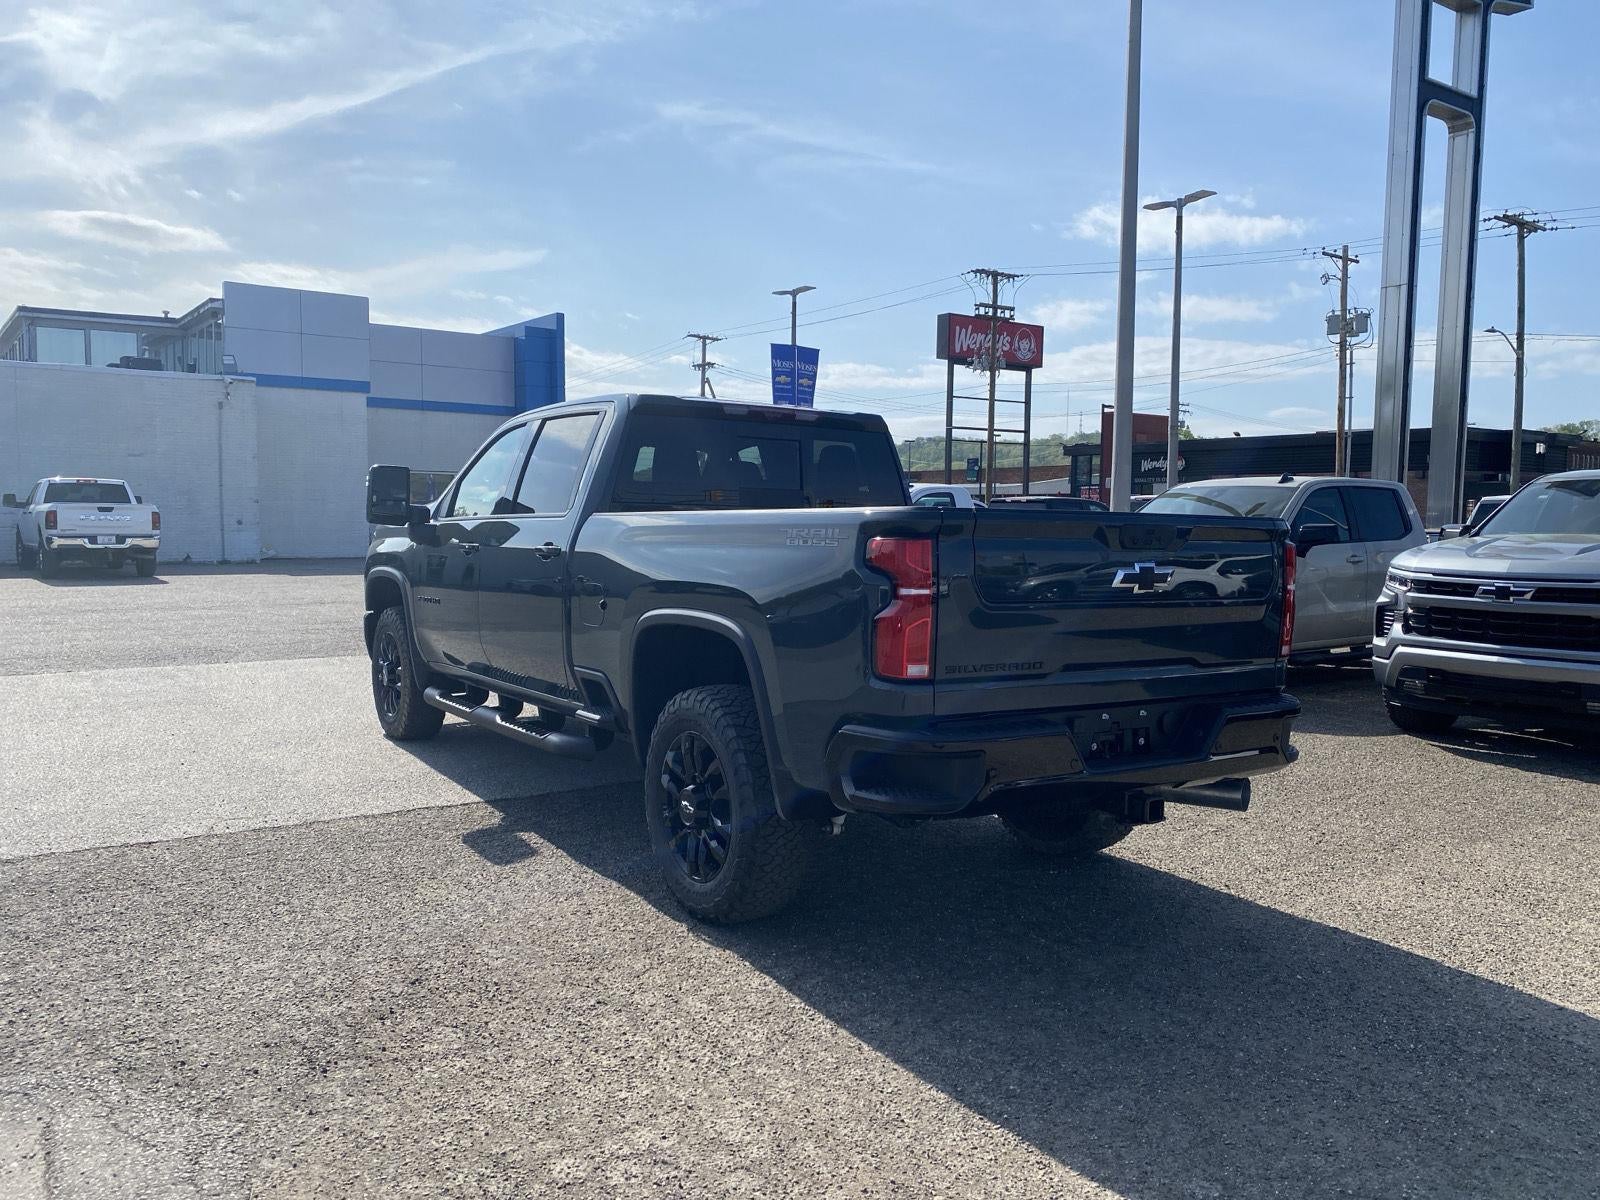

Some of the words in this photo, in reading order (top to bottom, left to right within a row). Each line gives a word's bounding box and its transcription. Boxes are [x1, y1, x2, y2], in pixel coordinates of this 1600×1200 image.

[954, 324, 1011, 357] Wendy's
[1141, 456, 1169, 472] Wendy
[777, 528, 849, 539] TRAIL
[785, 538, 840, 547] BOSS
[944, 661, 1045, 675] SILVERADO
